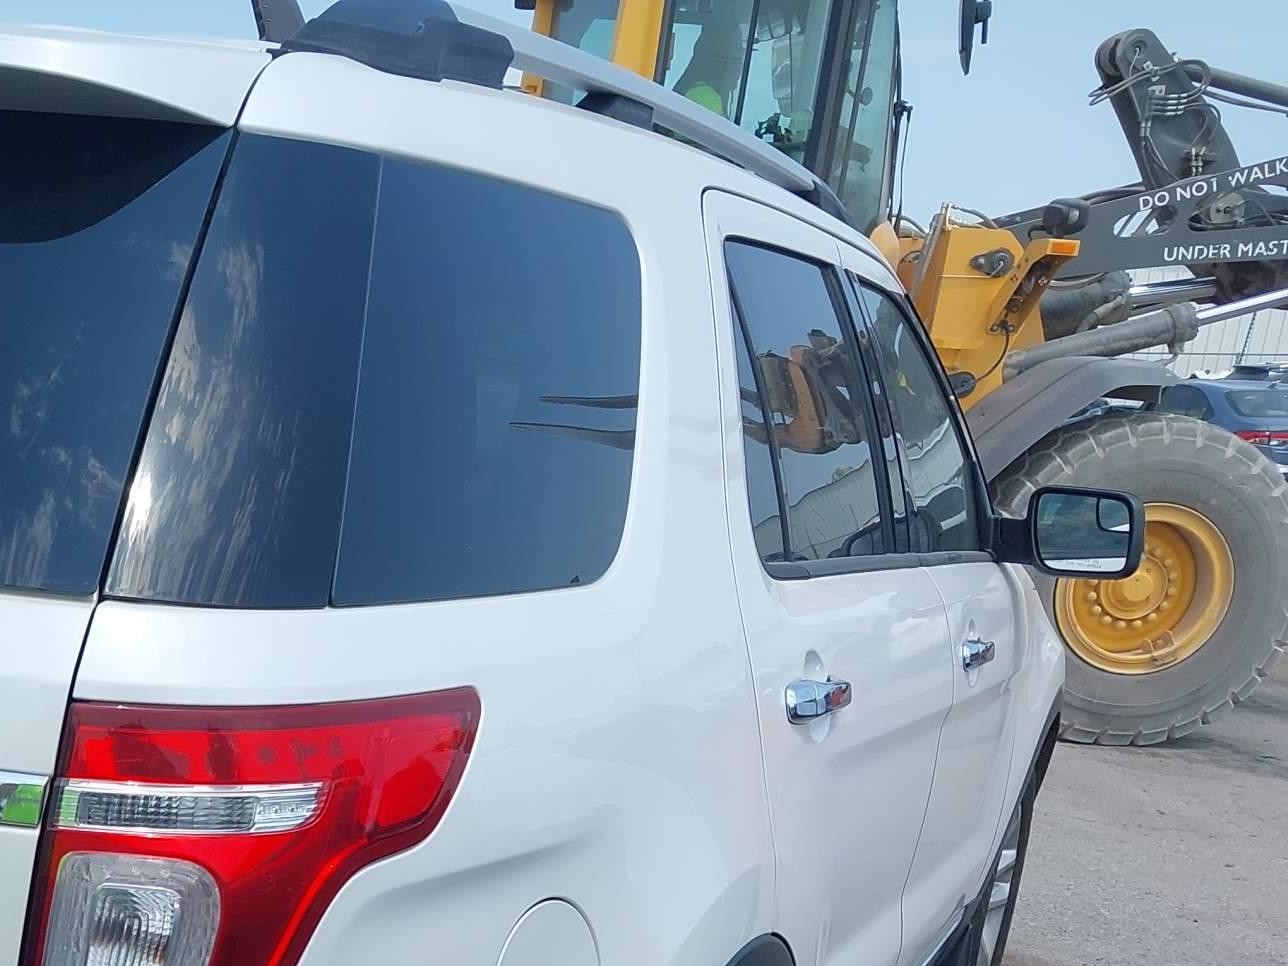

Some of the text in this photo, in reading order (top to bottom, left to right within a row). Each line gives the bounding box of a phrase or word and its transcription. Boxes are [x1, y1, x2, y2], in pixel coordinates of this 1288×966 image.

[1139, 157, 1288, 212] DO NOT WALK
[1163, 239, 1288, 262] UNDER MAST
